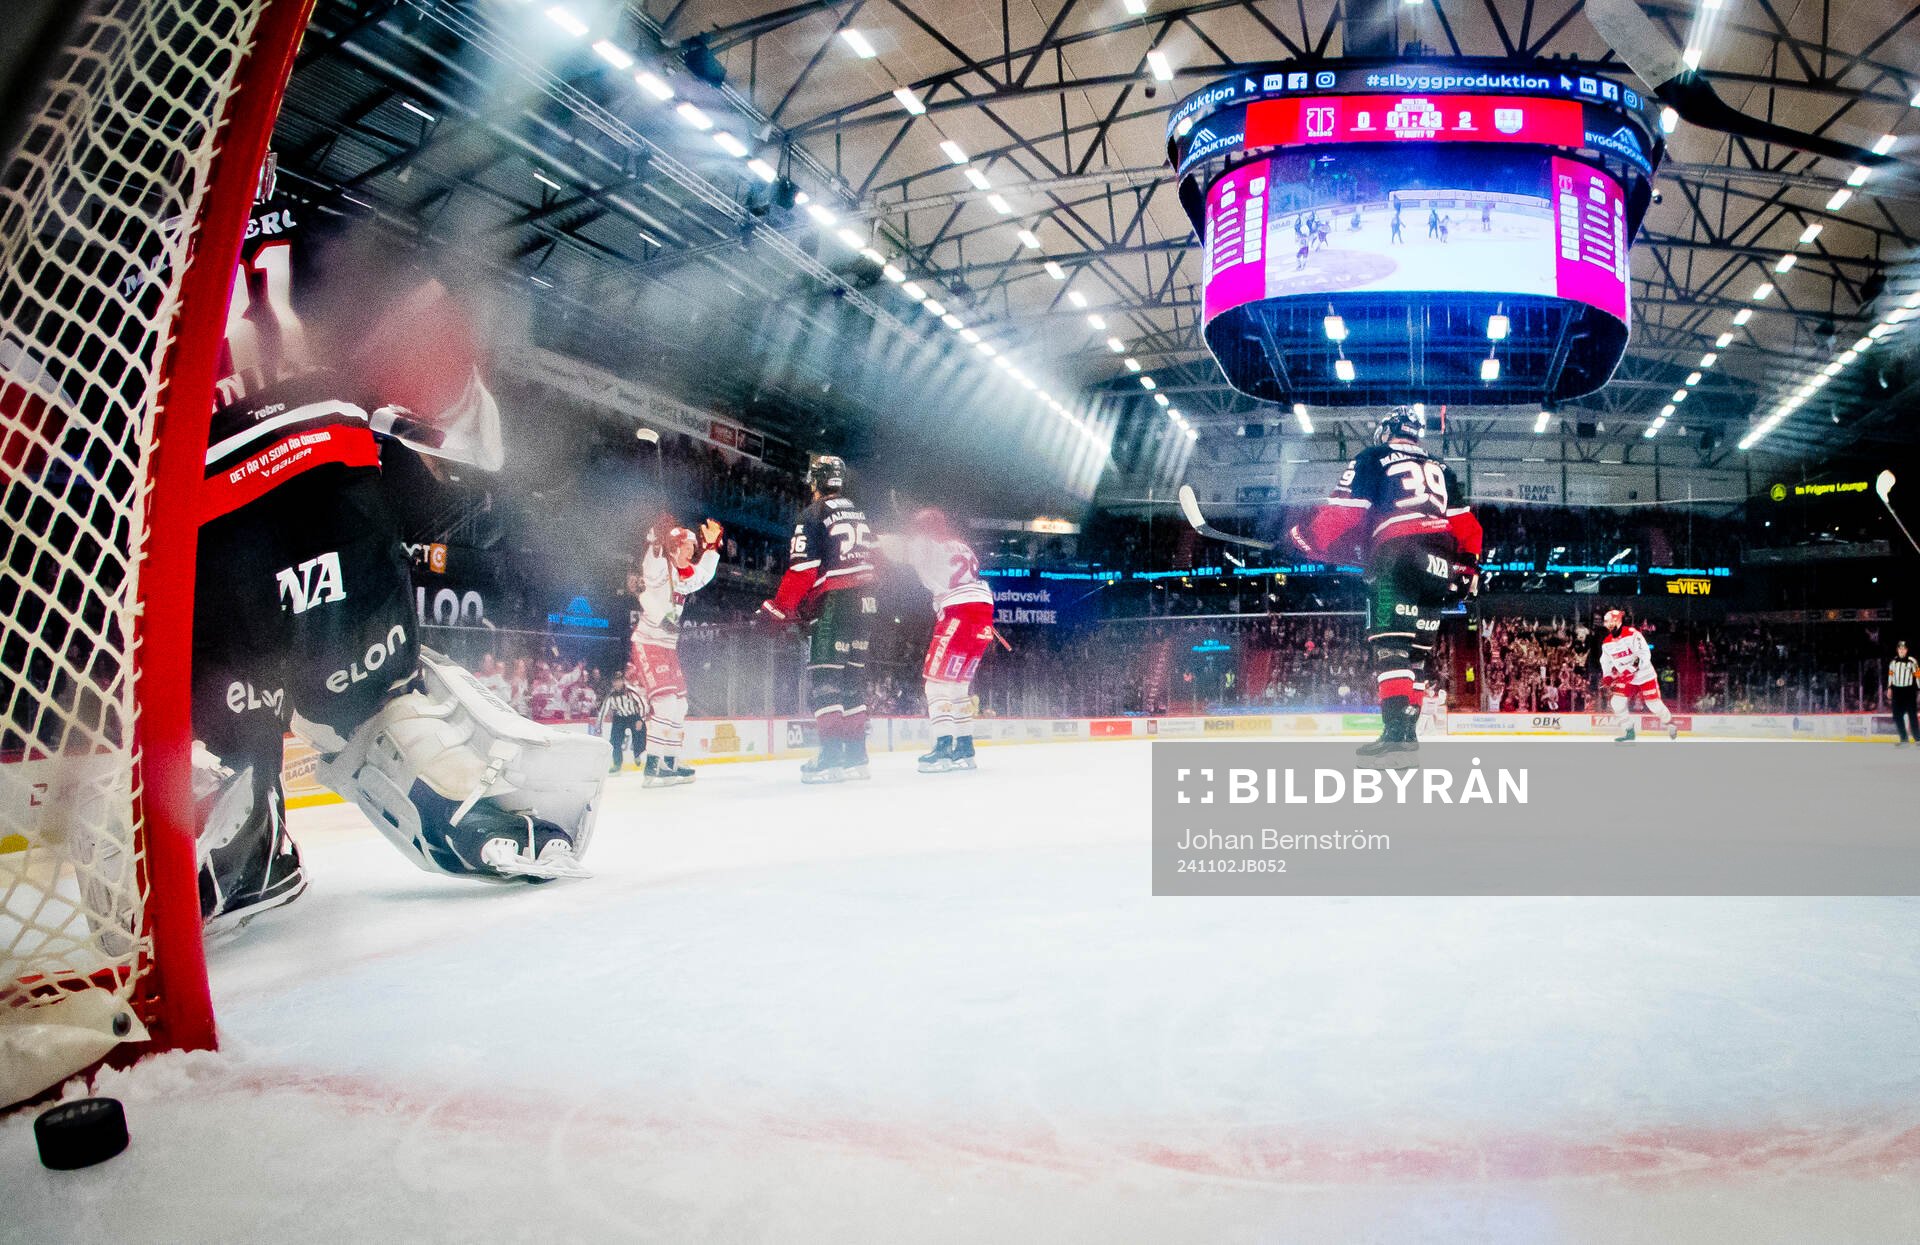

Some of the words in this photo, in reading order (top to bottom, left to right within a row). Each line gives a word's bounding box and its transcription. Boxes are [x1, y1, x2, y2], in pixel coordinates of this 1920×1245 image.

[1367, 74, 1550, 89] #slbyggproduktion
[1358, 111, 1370, 128] 0
[1387, 111, 1442, 128] 01:43
[1459, 111, 1472, 128] 2
[229, 467, 248, 484] DET
[246, 460, 260, 475] ÄR
[259, 454, 270, 467] VI
[268, 443, 290, 462] SOM
[288, 437, 302, 452] ÄR
[1386, 460, 1449, 514] 39
[1426, 554, 1449, 579] NA
[276, 551, 347, 615] NA
[1680, 580, 1711, 595] VIEW
[993, 588, 1051, 603] ustavsvik
[993, 608, 1057, 625] JELÄKTARE
[1532, 716, 1561, 727] OBK
